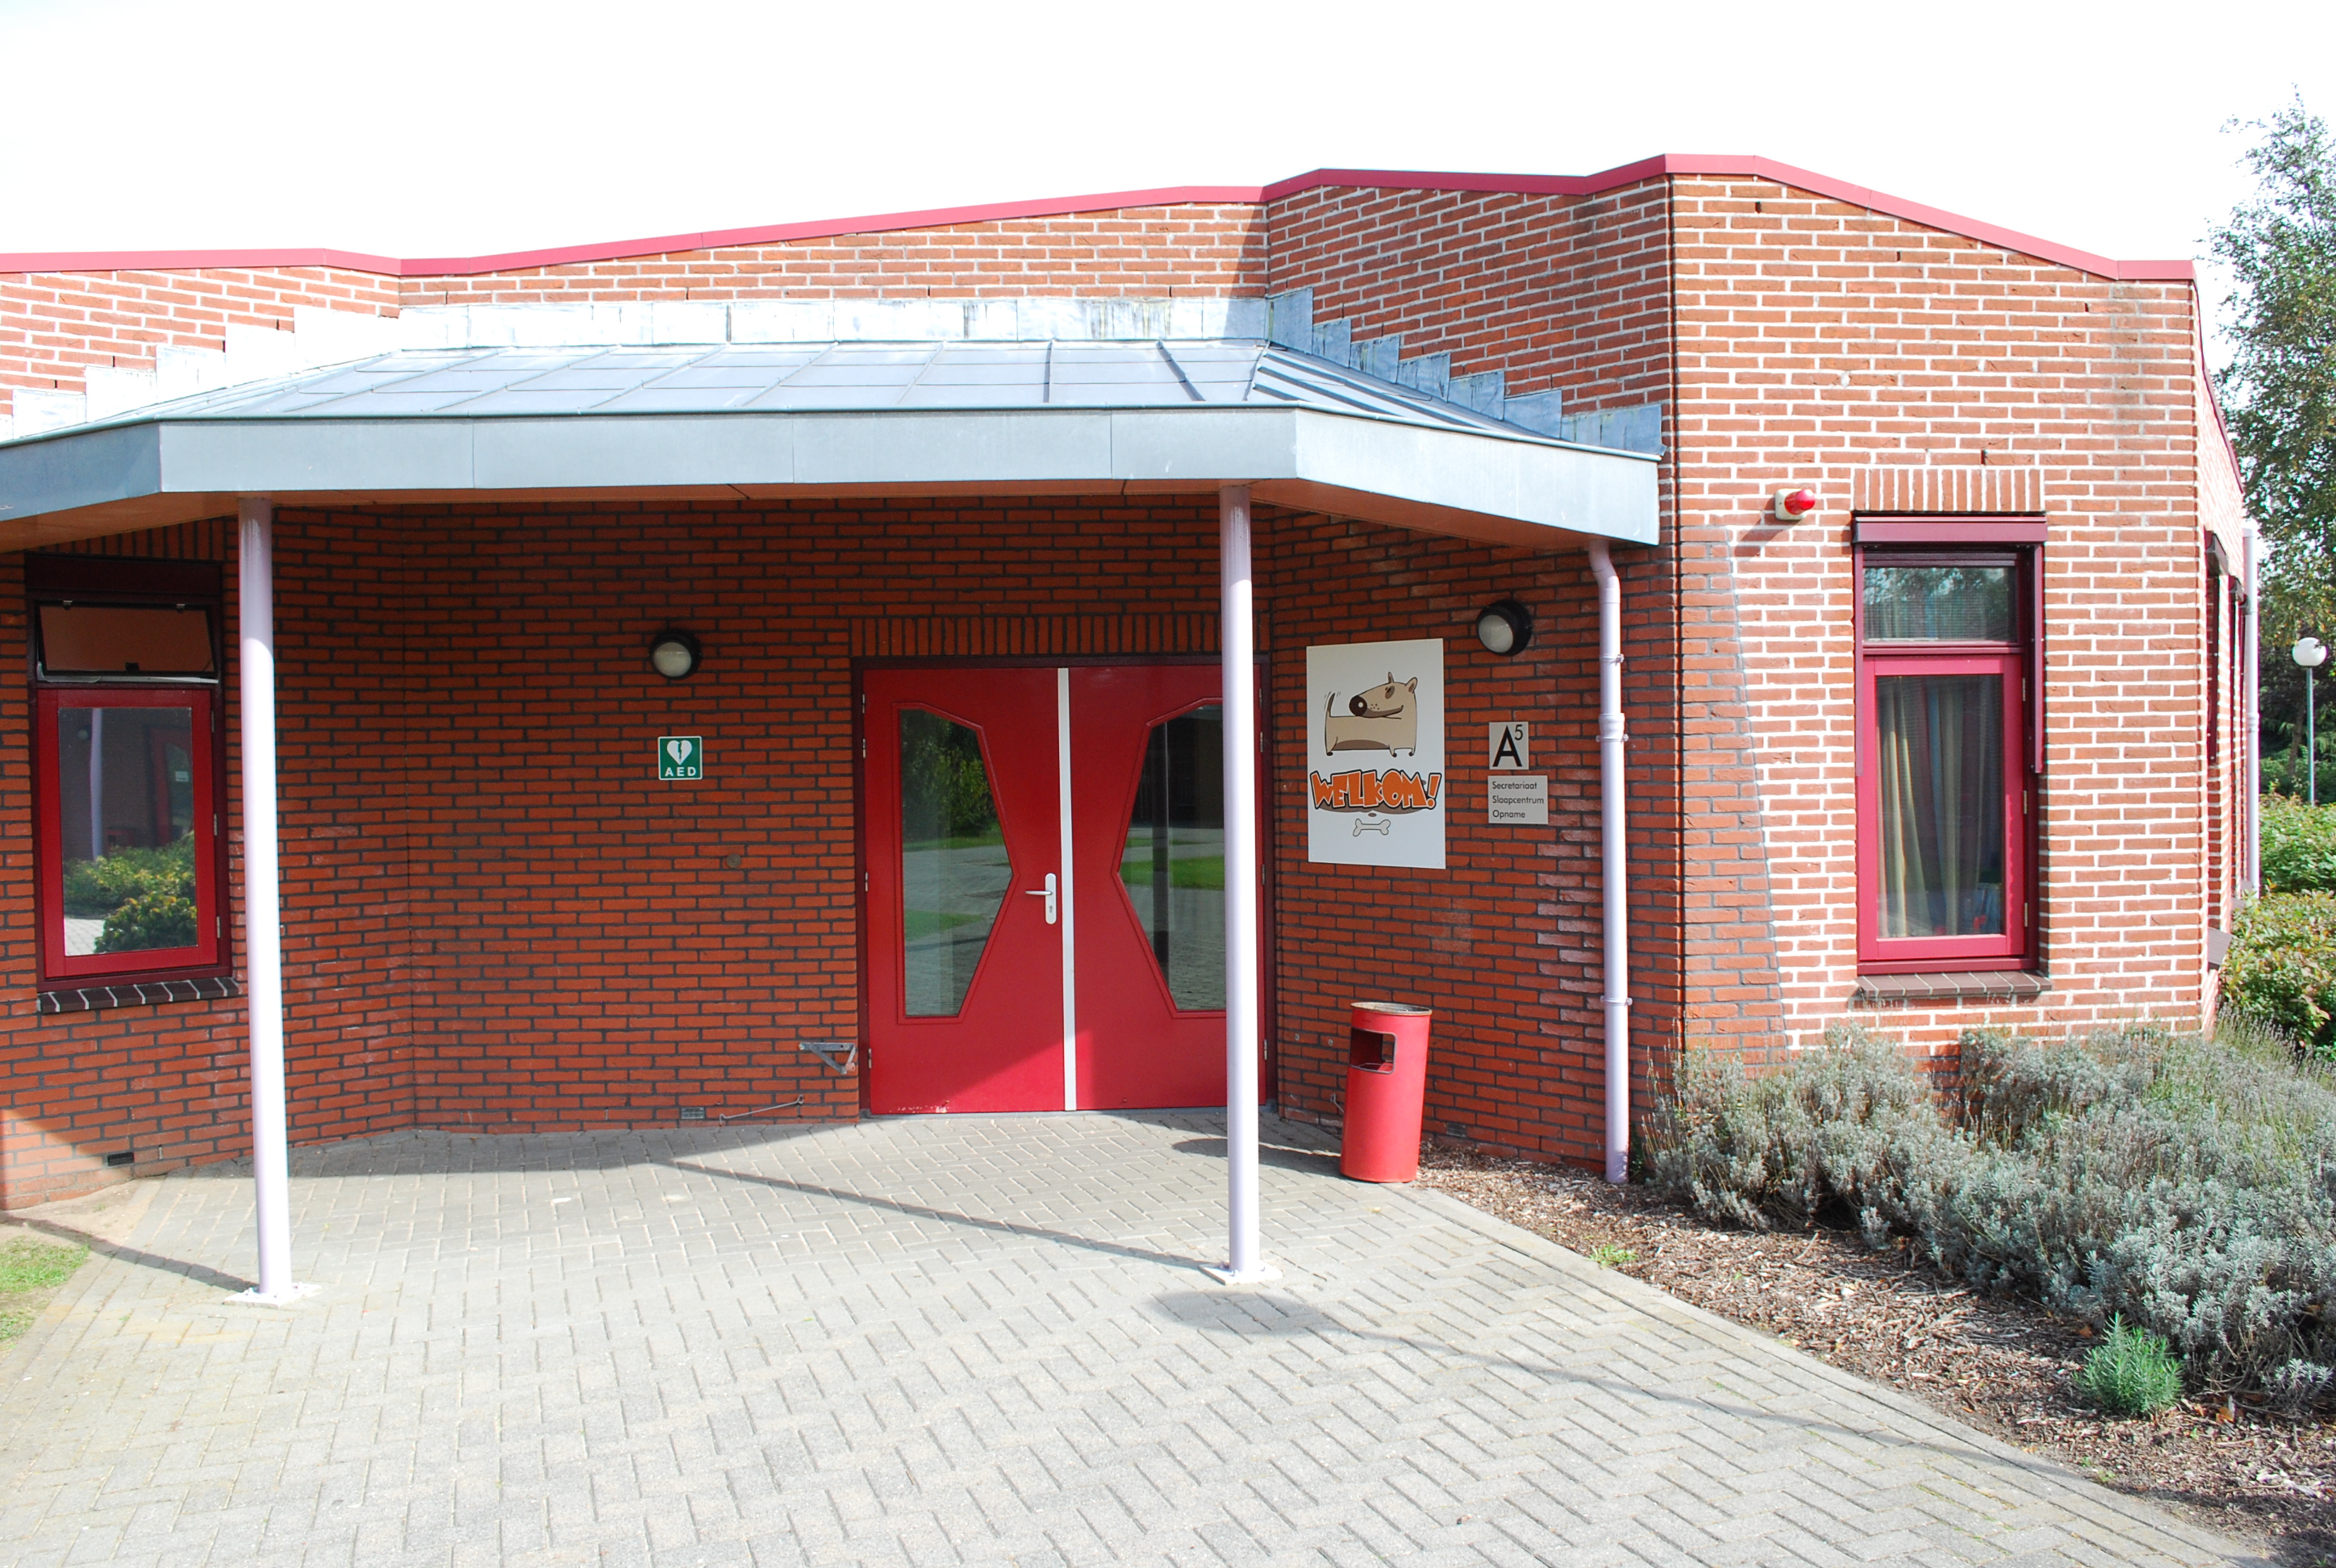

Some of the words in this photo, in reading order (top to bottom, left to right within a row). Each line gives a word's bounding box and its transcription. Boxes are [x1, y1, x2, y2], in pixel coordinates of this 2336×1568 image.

[665, 766, 696, 777] AED
[1310, 768, 1442, 810] WELKOM!
[1492, 781, 1537, 790] Secretariaat
[1492, 795, 1544, 806] Slaapcentrum
[1492, 809, 1525, 819] Opname
